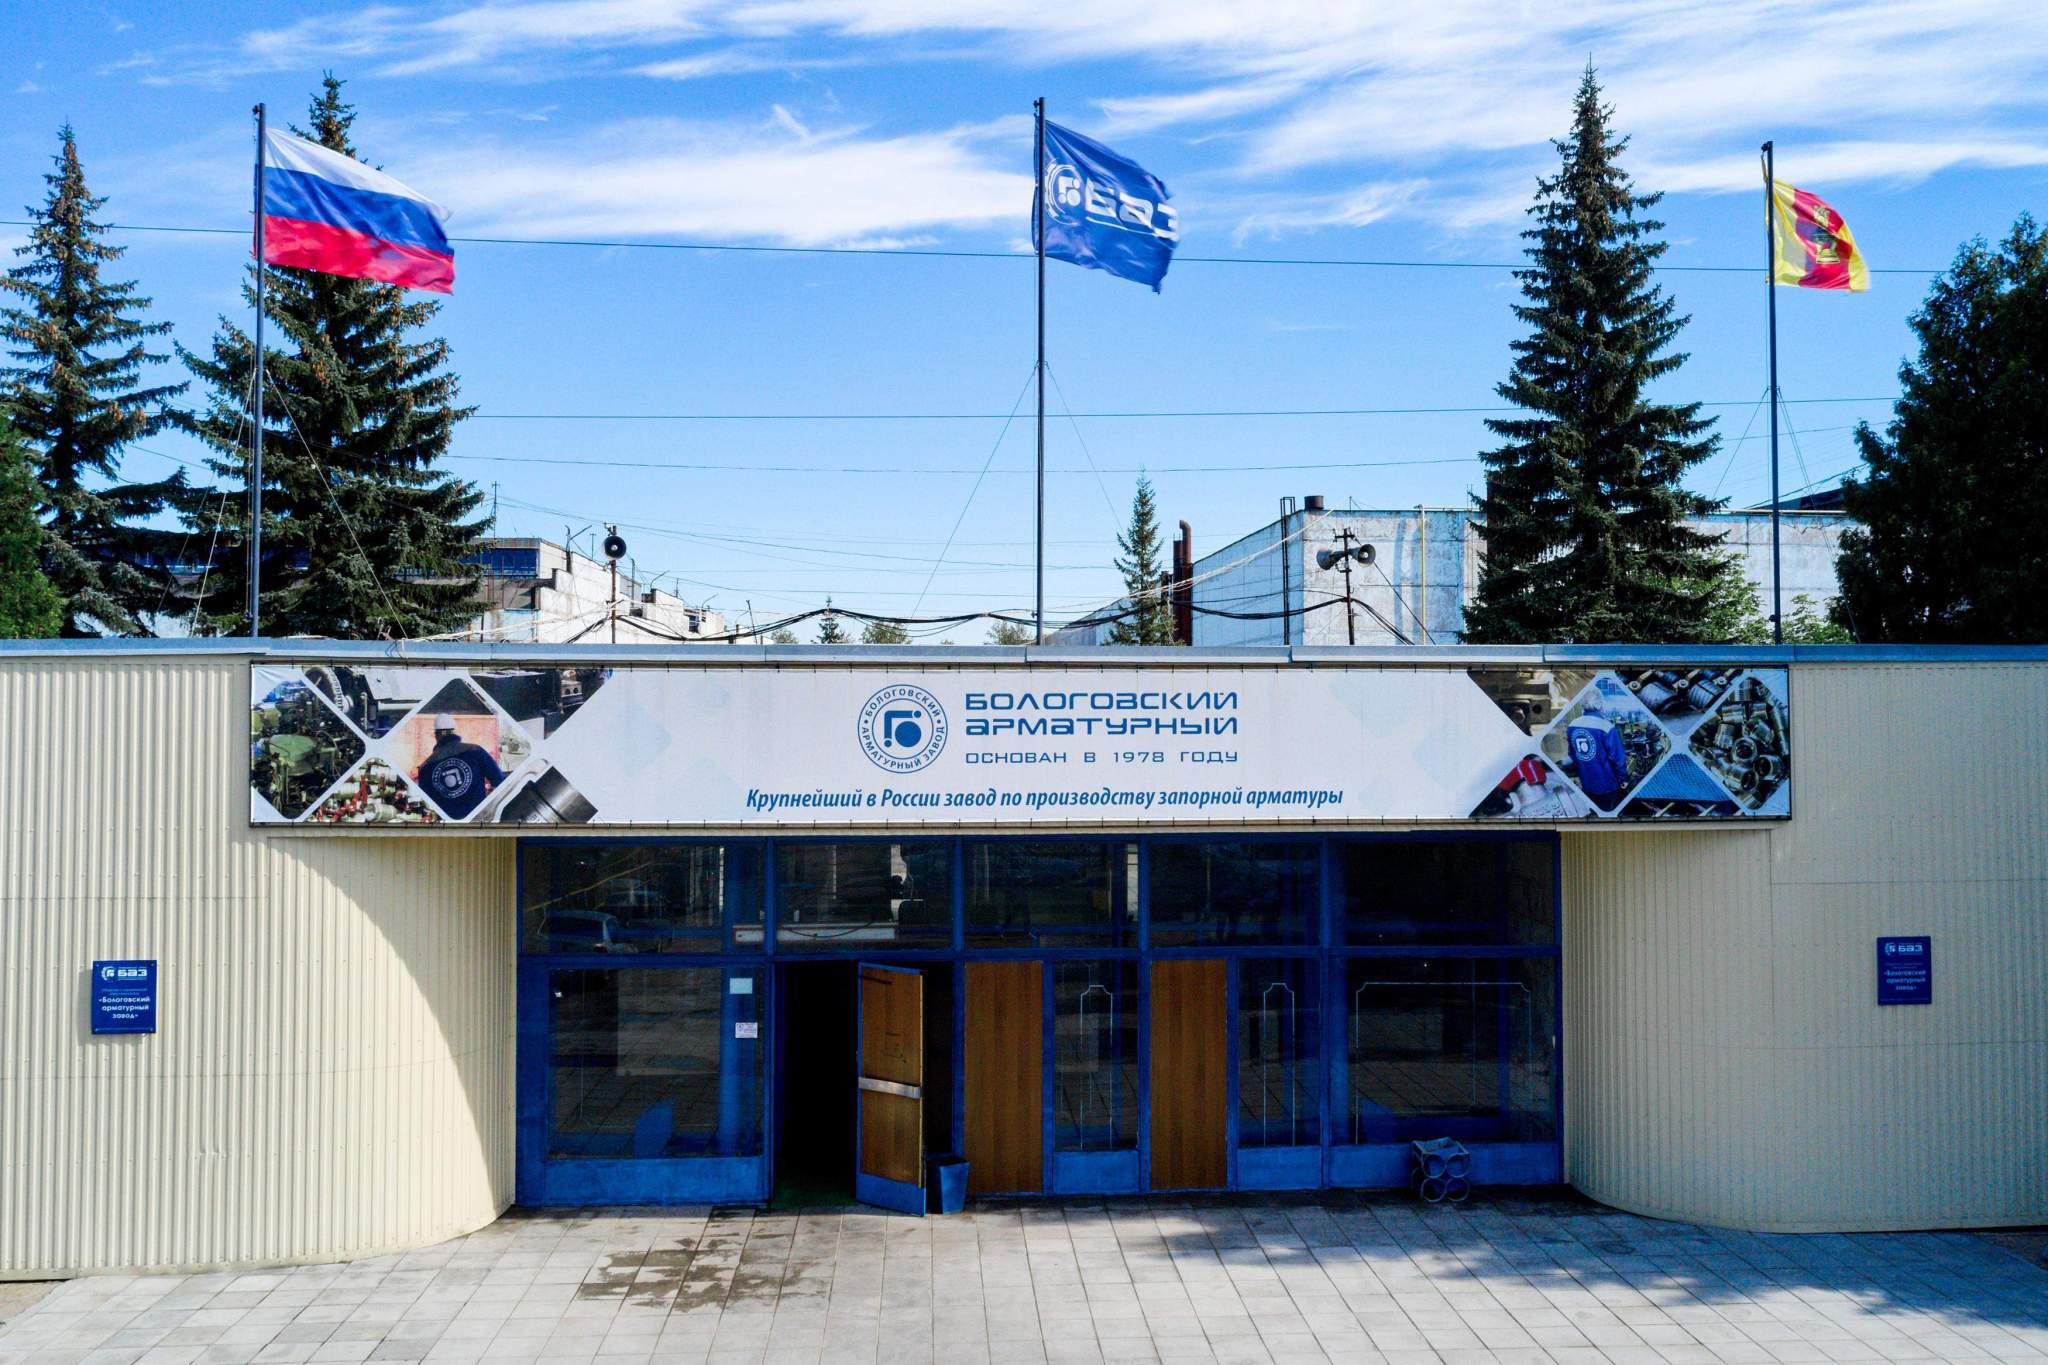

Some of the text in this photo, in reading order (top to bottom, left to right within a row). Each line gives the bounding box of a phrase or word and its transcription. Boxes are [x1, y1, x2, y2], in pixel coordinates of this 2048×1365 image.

[865, 688, 941, 718] БОЛОГОВСКИЙ
[965, 692, 1238, 711] БОЛОГОВСКИЙ
[861, 726, 945, 769] АРМАТУРНЫЙ ЗАВОД
[965, 751, 1238, 764] ОСНОВАН В 1978 ГОДУ
[746, 787, 1344, 812] Крупнейший в России завод по производству запорной арматуры
